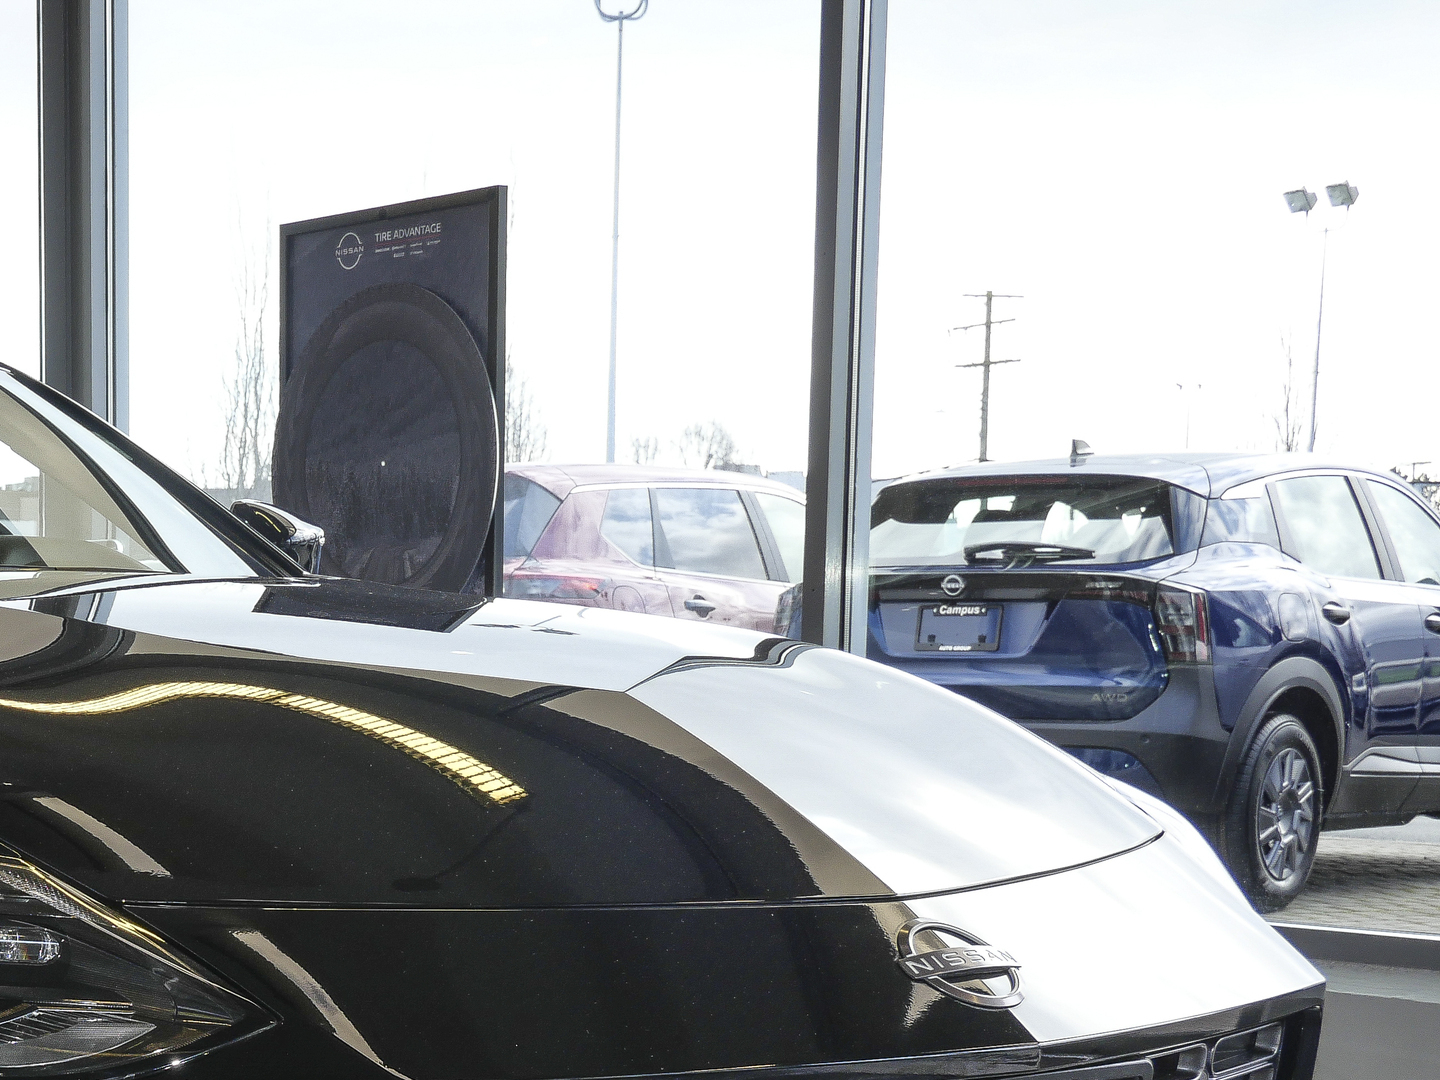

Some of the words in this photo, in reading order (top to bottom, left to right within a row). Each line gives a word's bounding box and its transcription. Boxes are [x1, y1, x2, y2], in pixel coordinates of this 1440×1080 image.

[374, 230, 392, 242] TIRE
[393, 222, 442, 240] ADVANTAGE
[335, 245, 364, 256] NISSAN
[939, 605, 980, 616] Campus
[1091, 693, 1128, 703] AWD
[904, 948, 1018, 975] NISSAN
